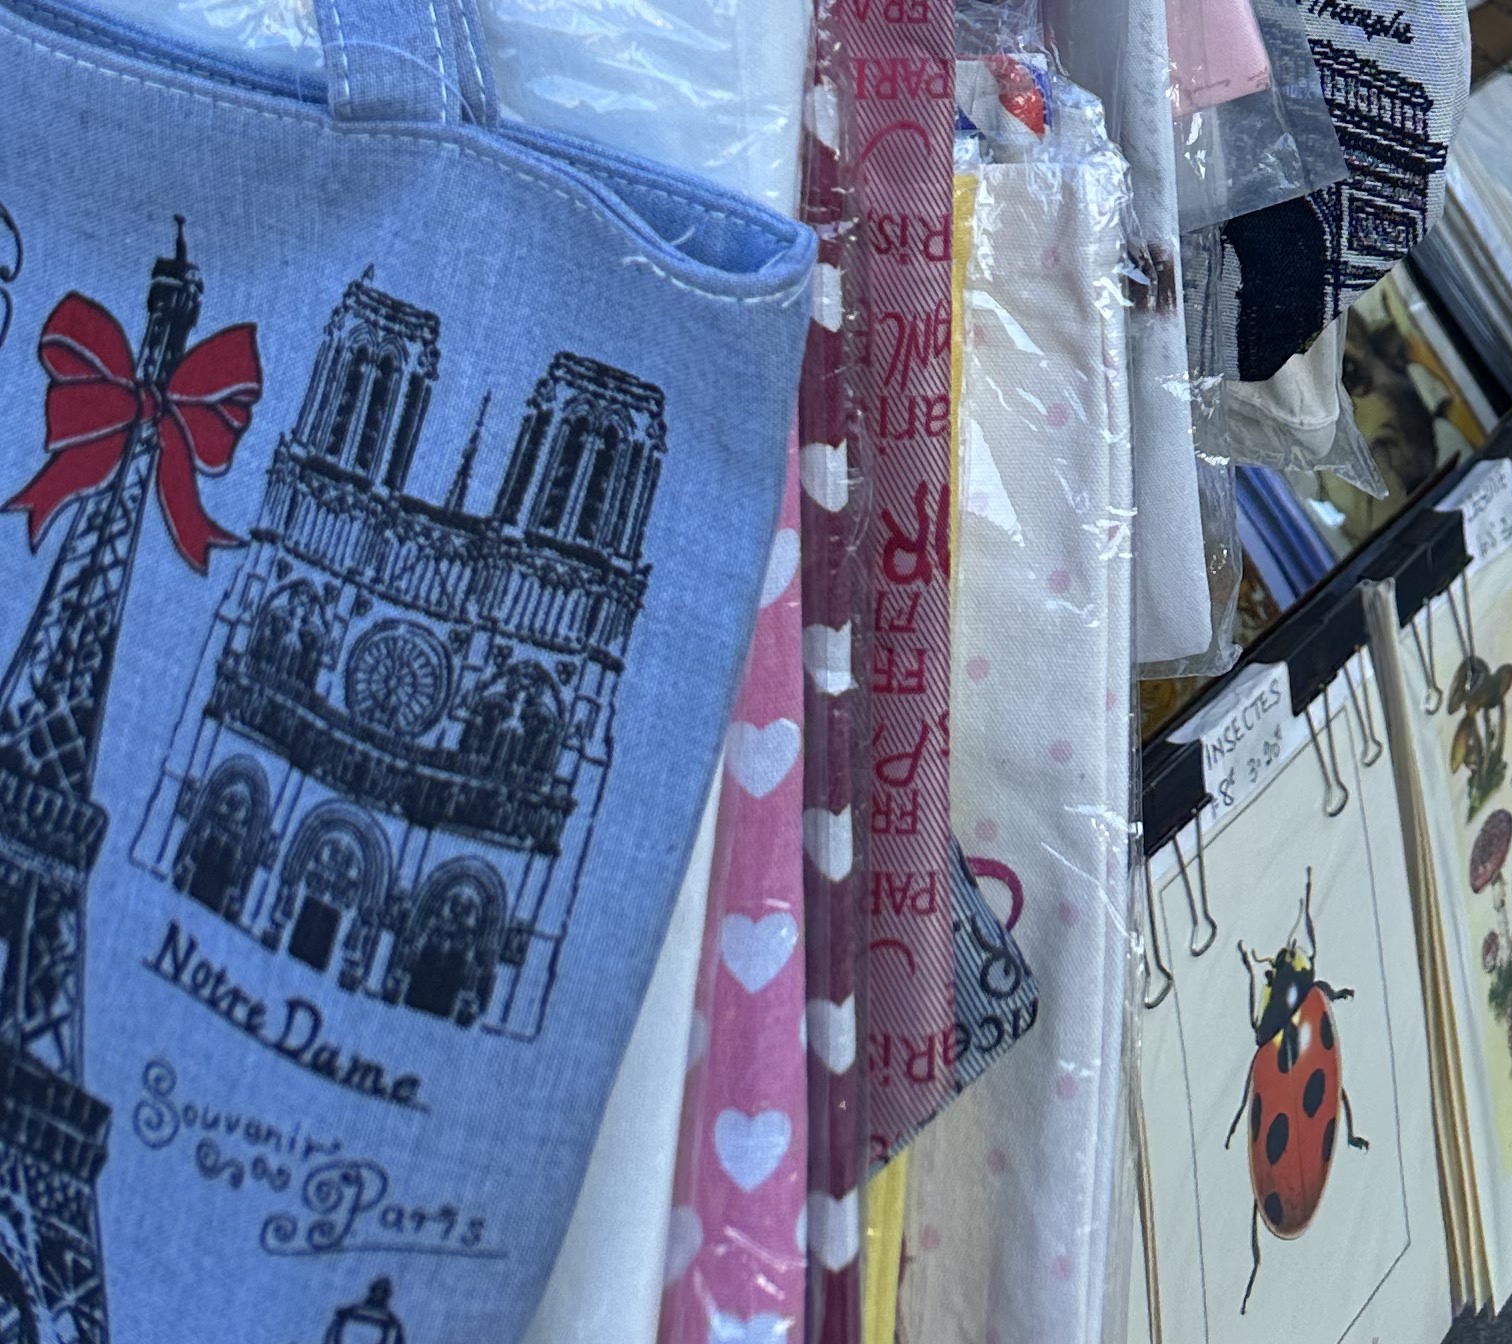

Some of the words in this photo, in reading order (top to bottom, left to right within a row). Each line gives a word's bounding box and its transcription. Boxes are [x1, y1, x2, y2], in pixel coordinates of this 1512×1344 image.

[1203, 677, 1282, 771] INSECTES
[144, 918, 268, 1034] Notre
[270, 995, 424, 1106] Dame
